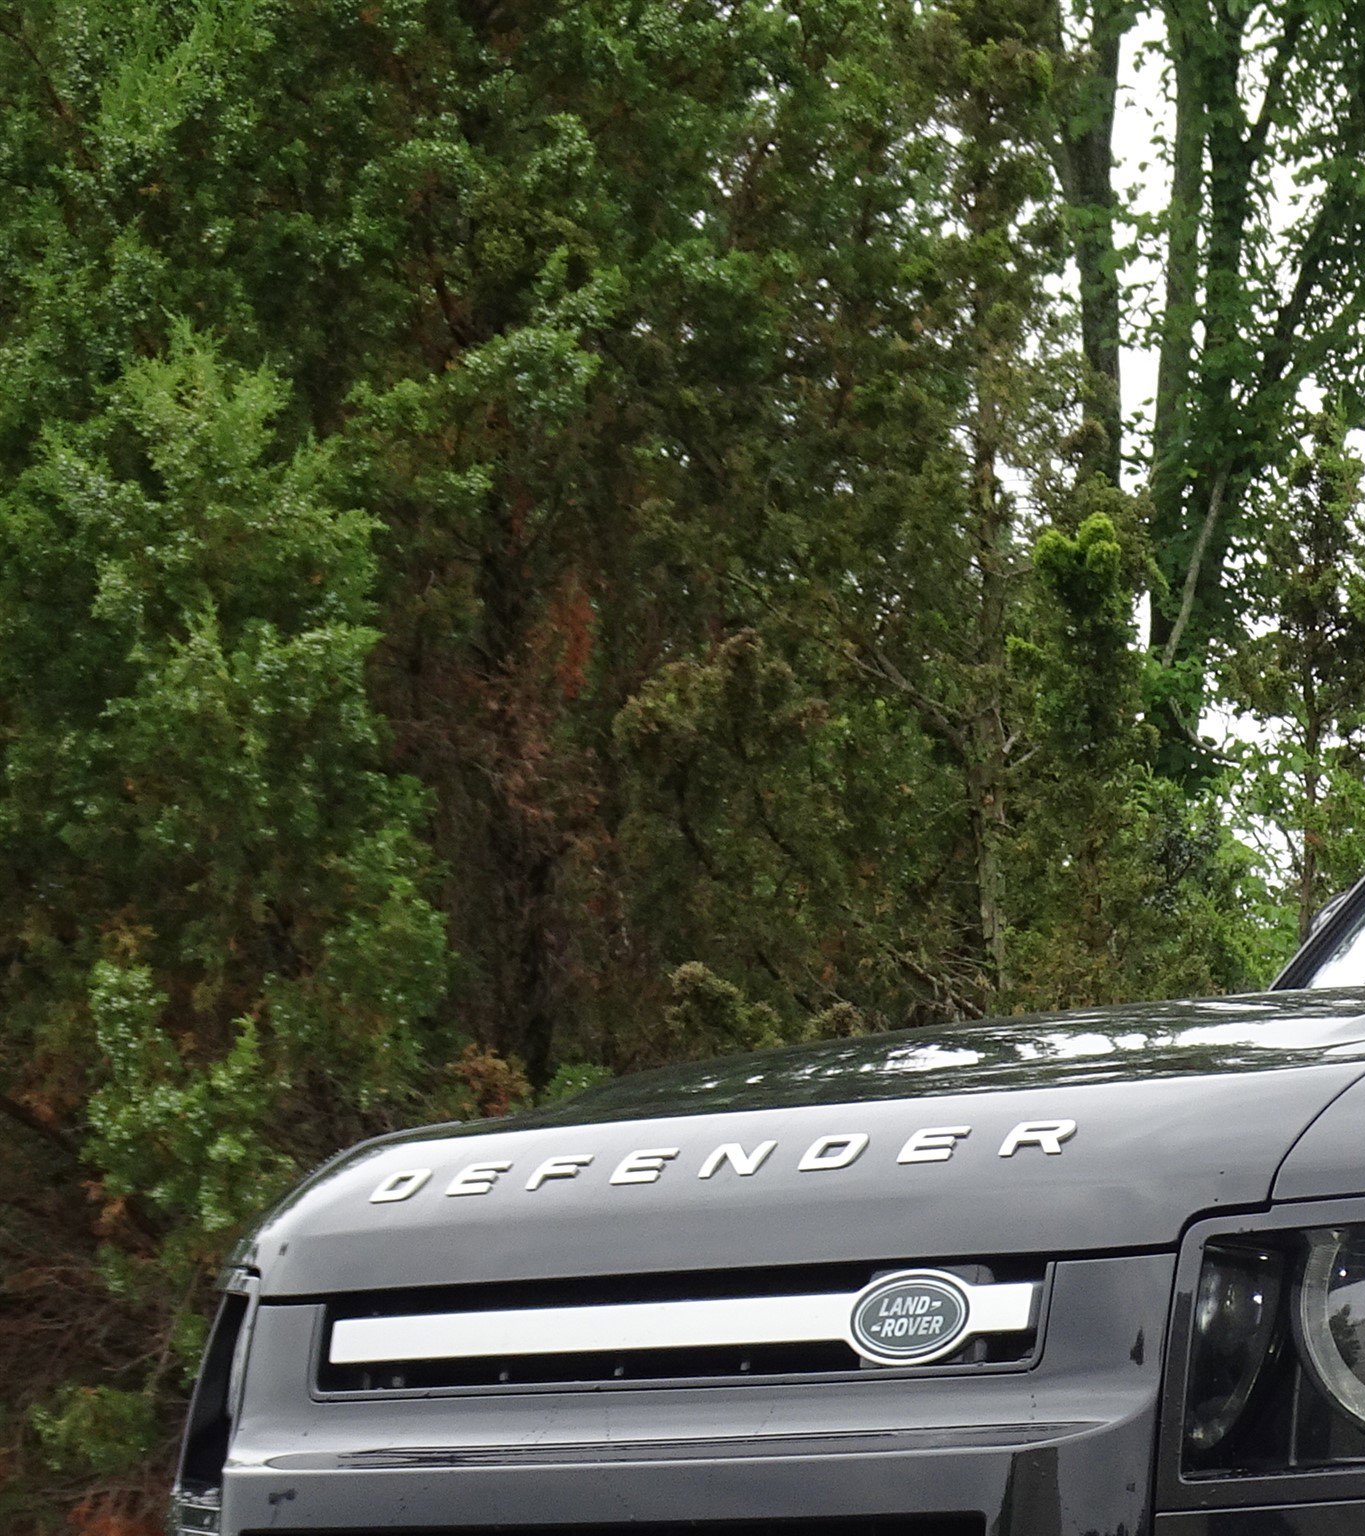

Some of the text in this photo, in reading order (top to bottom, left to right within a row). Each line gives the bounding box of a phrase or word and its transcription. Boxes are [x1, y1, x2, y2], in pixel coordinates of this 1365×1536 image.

[368, 1117, 1078, 1204] DEFENDER
[878, 1295, 931, 1317] LAND
[880, 1315, 944, 1338] ROVER
